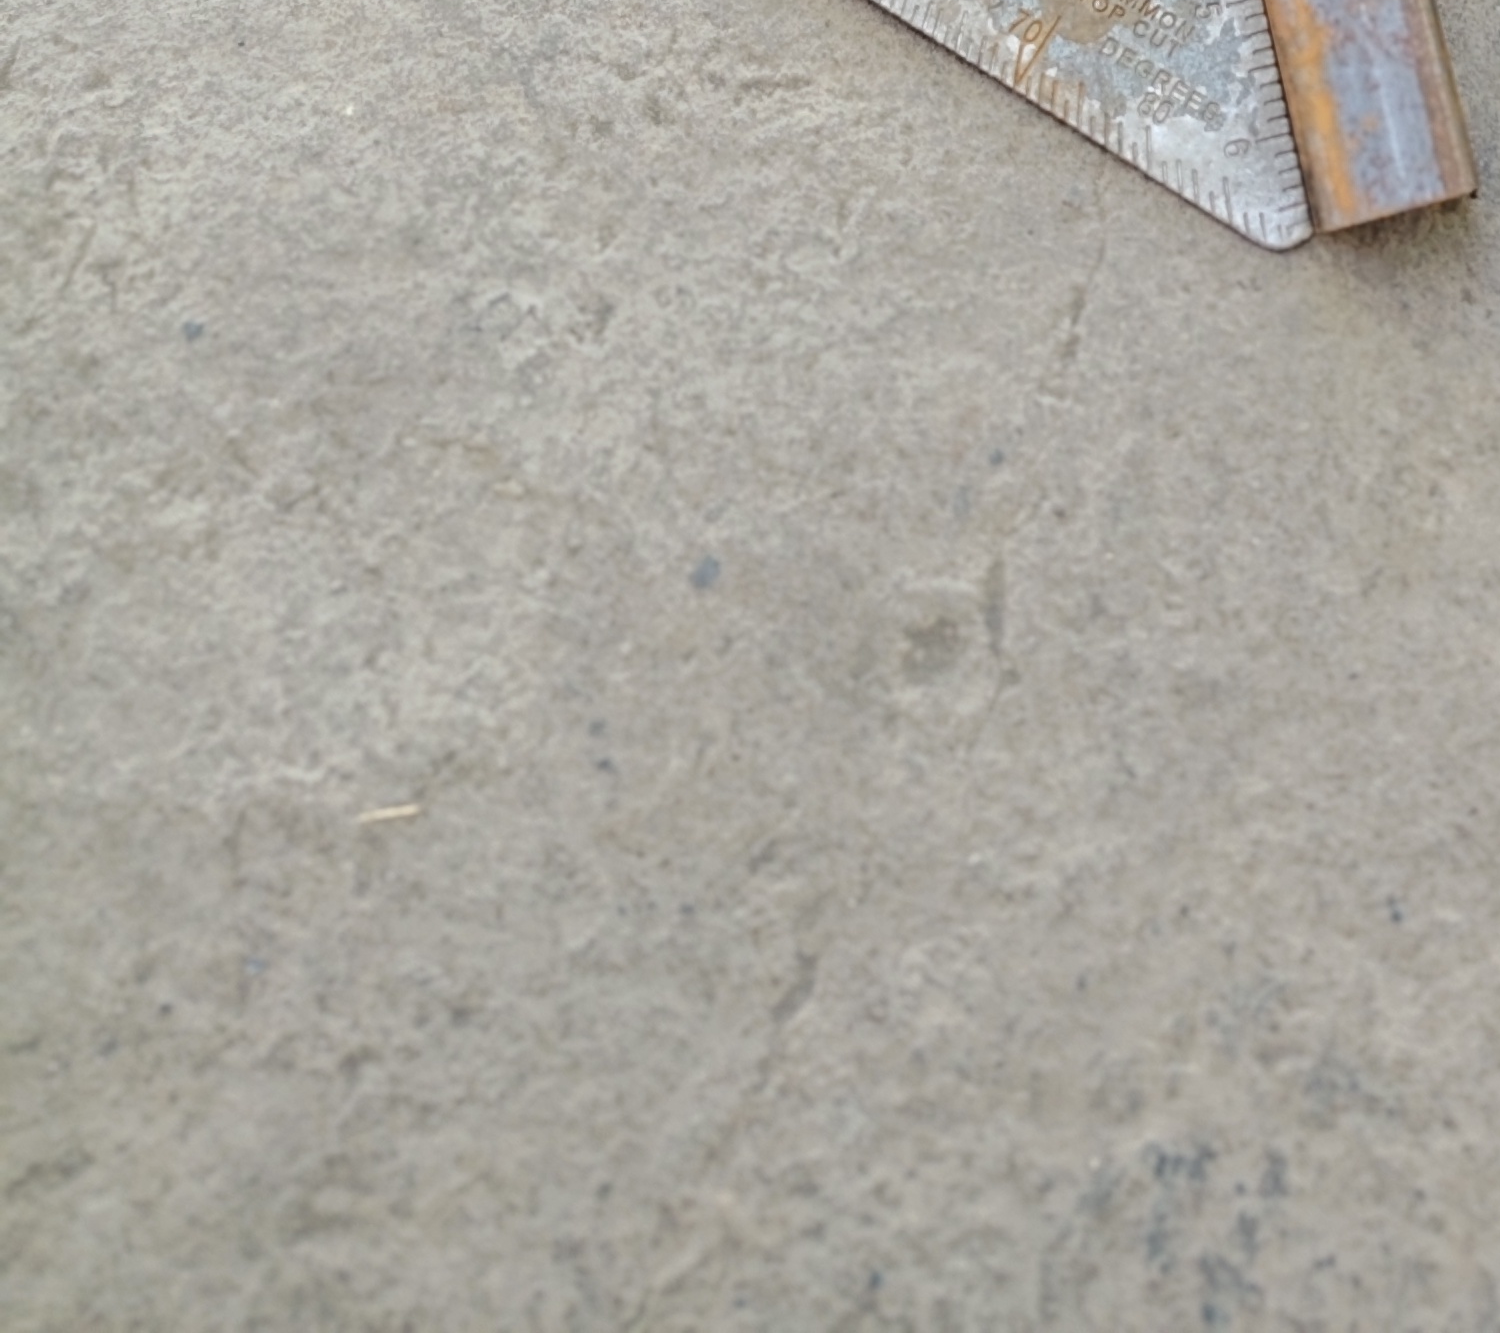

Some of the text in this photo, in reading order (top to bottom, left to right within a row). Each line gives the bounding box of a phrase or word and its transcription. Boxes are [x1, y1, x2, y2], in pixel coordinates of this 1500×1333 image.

[1008, 7, 1044, 44] 70
[1193, 1, 1222, 20] 5
[1131, 18, 1188, 59] CUT
[1098, 35, 1222, 124] DEGREES
